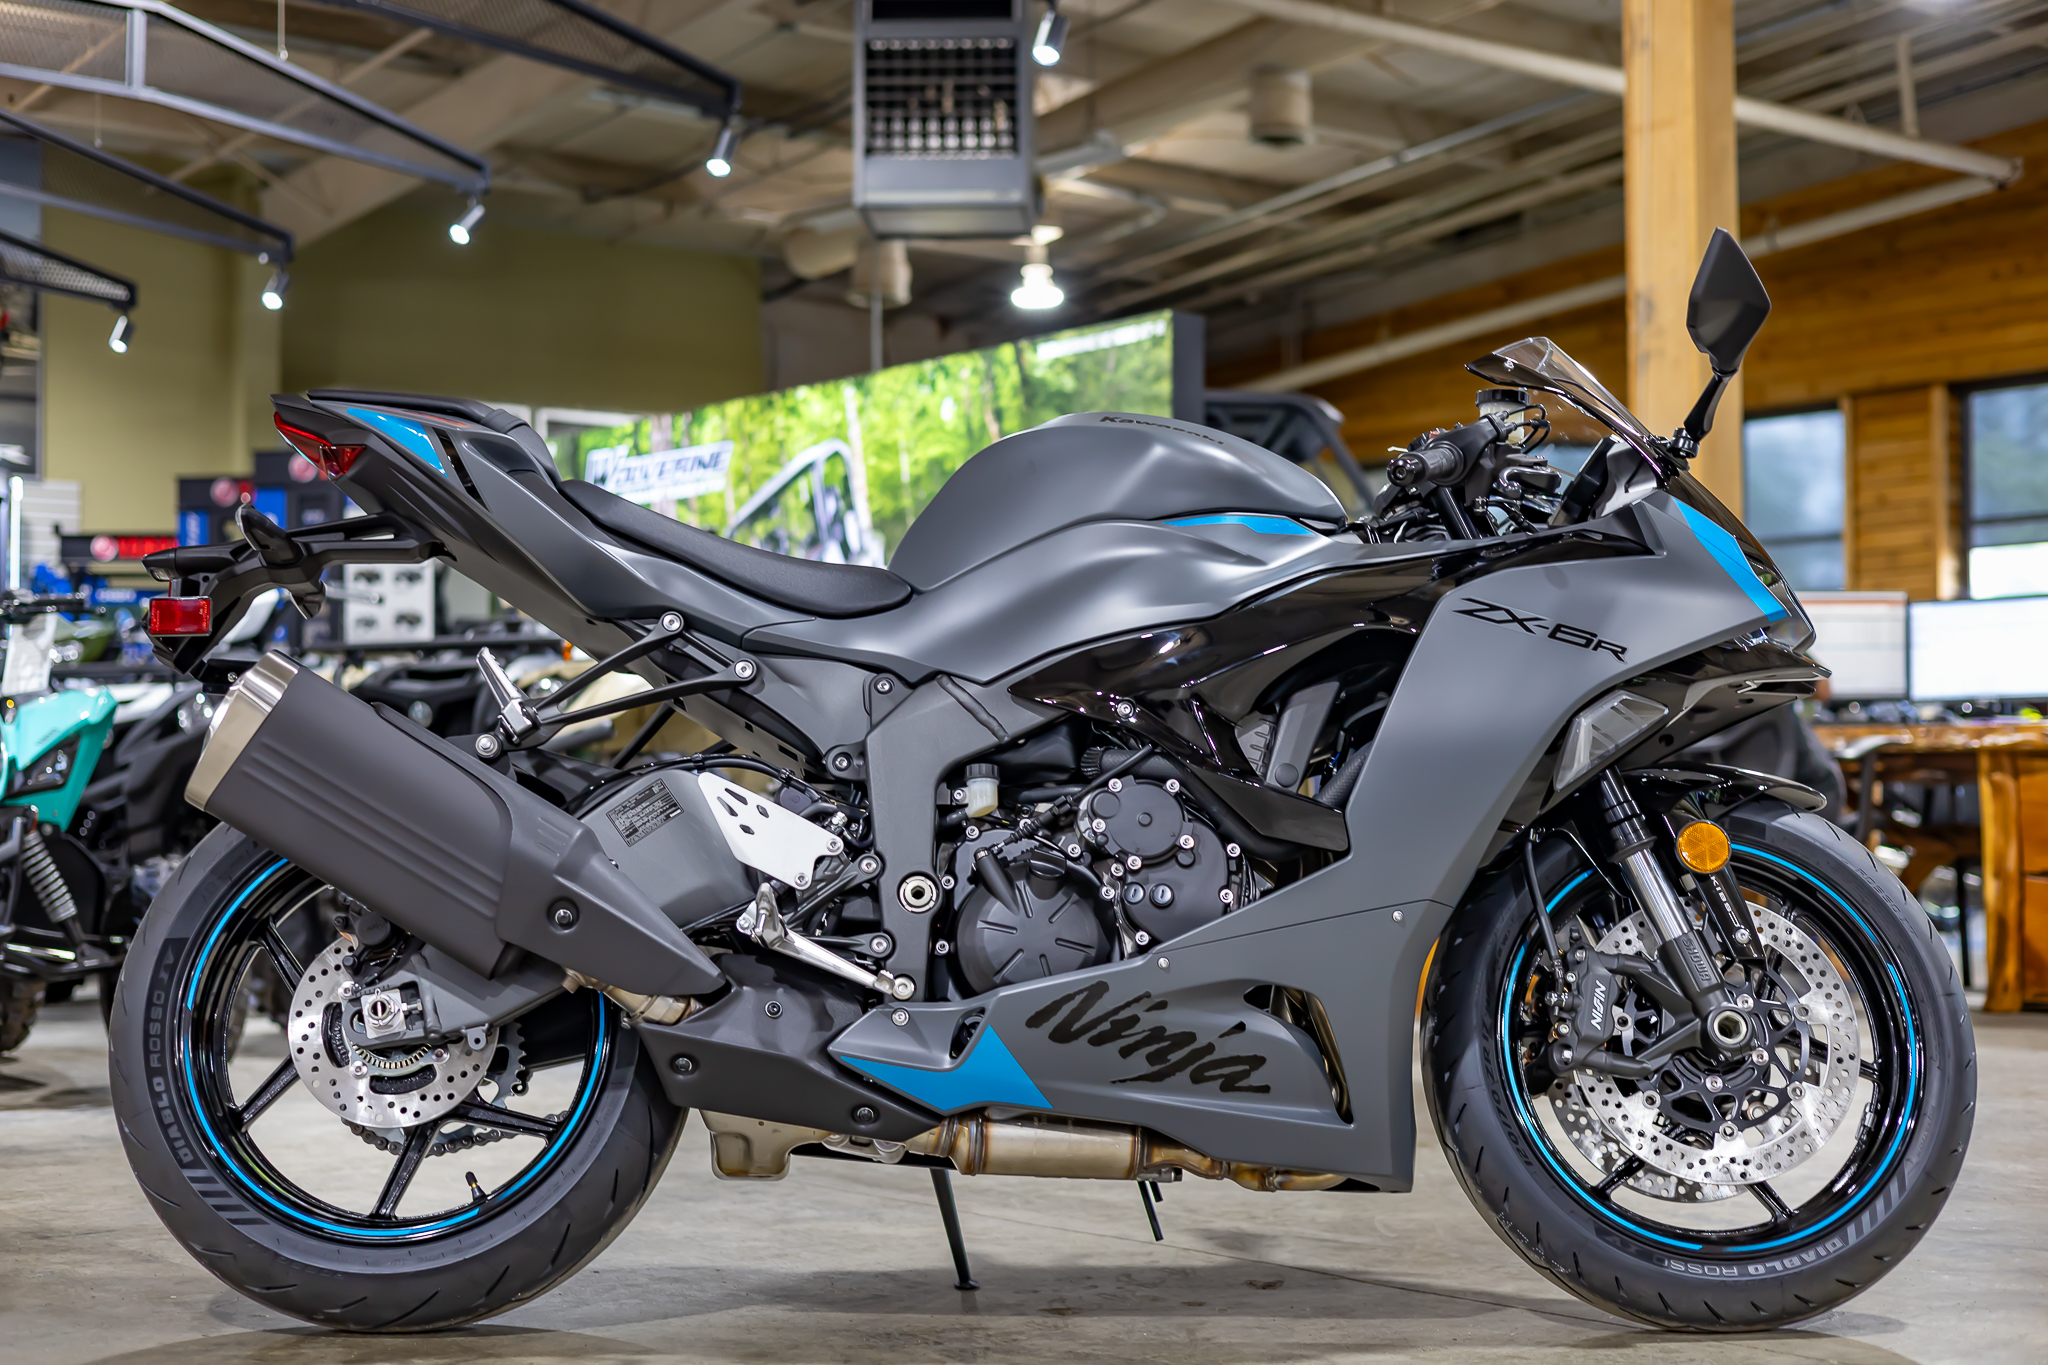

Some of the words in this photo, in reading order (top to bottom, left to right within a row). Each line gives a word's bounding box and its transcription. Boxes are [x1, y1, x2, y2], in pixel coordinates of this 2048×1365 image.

[1099, 416, 1225, 445] Kawasaki
[1452, 597, 1627, 664] ZX-6R
[1681, 937, 1712, 983] SHOWA
[149, 990, 166, 1068] ROSSO
[1024, 979, 1271, 1094] Ninja
[152, 1076, 194, 1165] DIABLO
[1652, 1252, 1738, 1277] ROSSO
[1747, 1234, 1845, 1276] DIABLO
